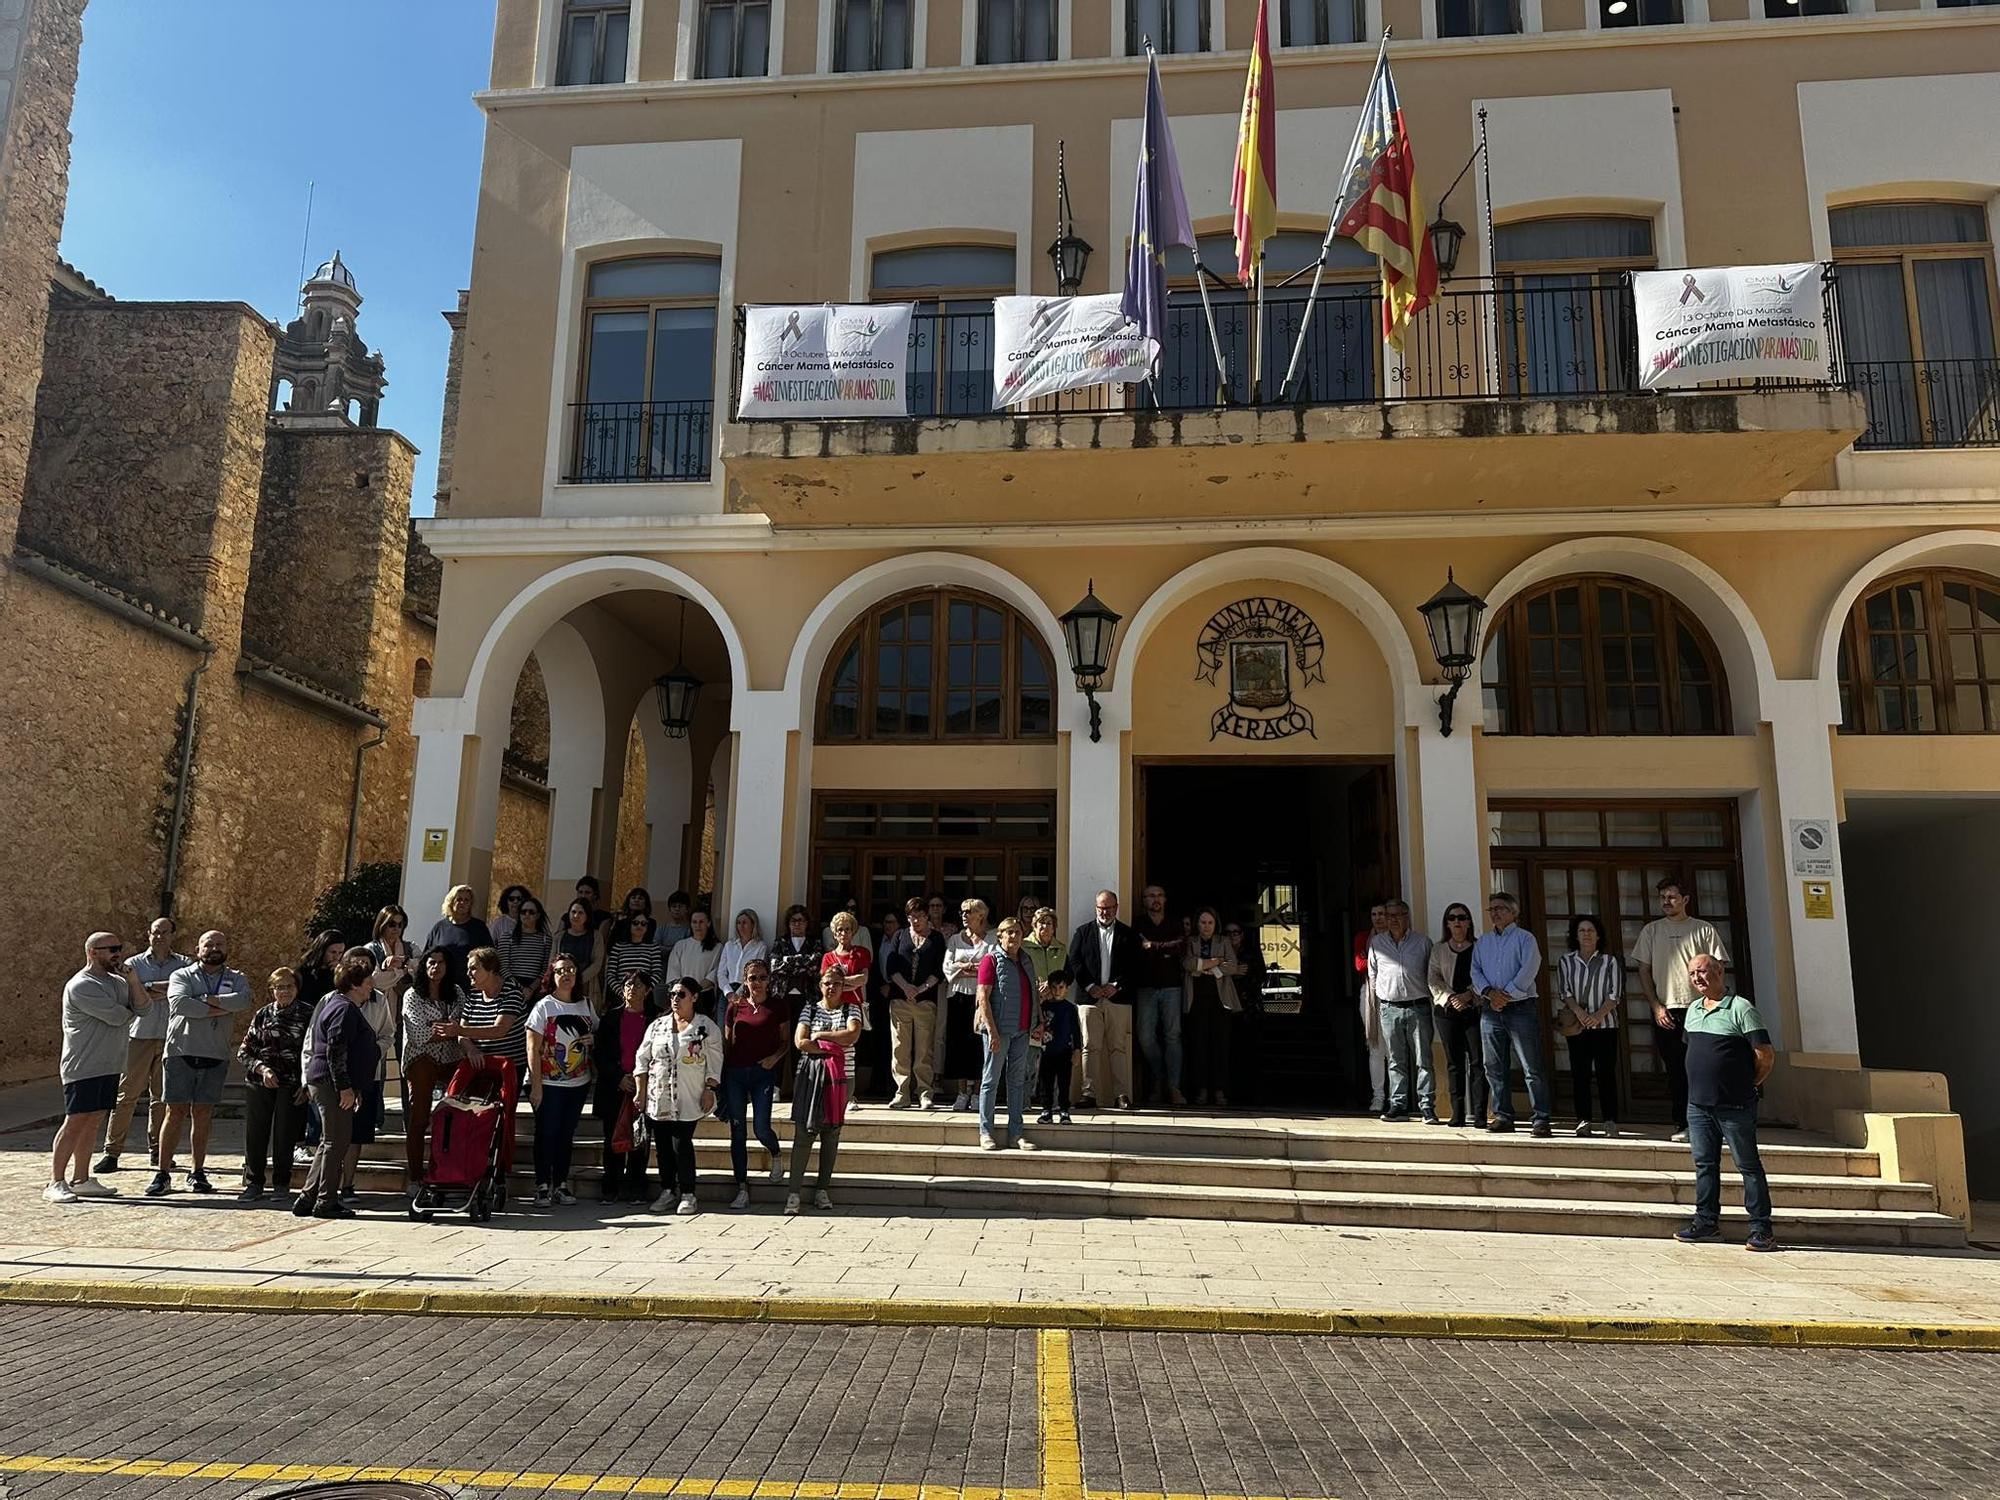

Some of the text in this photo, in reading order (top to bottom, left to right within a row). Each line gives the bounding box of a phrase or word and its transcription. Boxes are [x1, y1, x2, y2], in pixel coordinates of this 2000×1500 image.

[1695, 310, 1734, 321] Octubre
[1655, 316, 1816, 341] Cáncer Mama Metastásico
[1044, 337, 1078, 350] Mama
[790, 350, 825, 359] Octubre
[757, 359, 895, 371] Cáncer Mama Metastásico
[1198, 598, 1324, 656] AJUNTAMENT
[1216, 711, 1307, 740] XERACO
